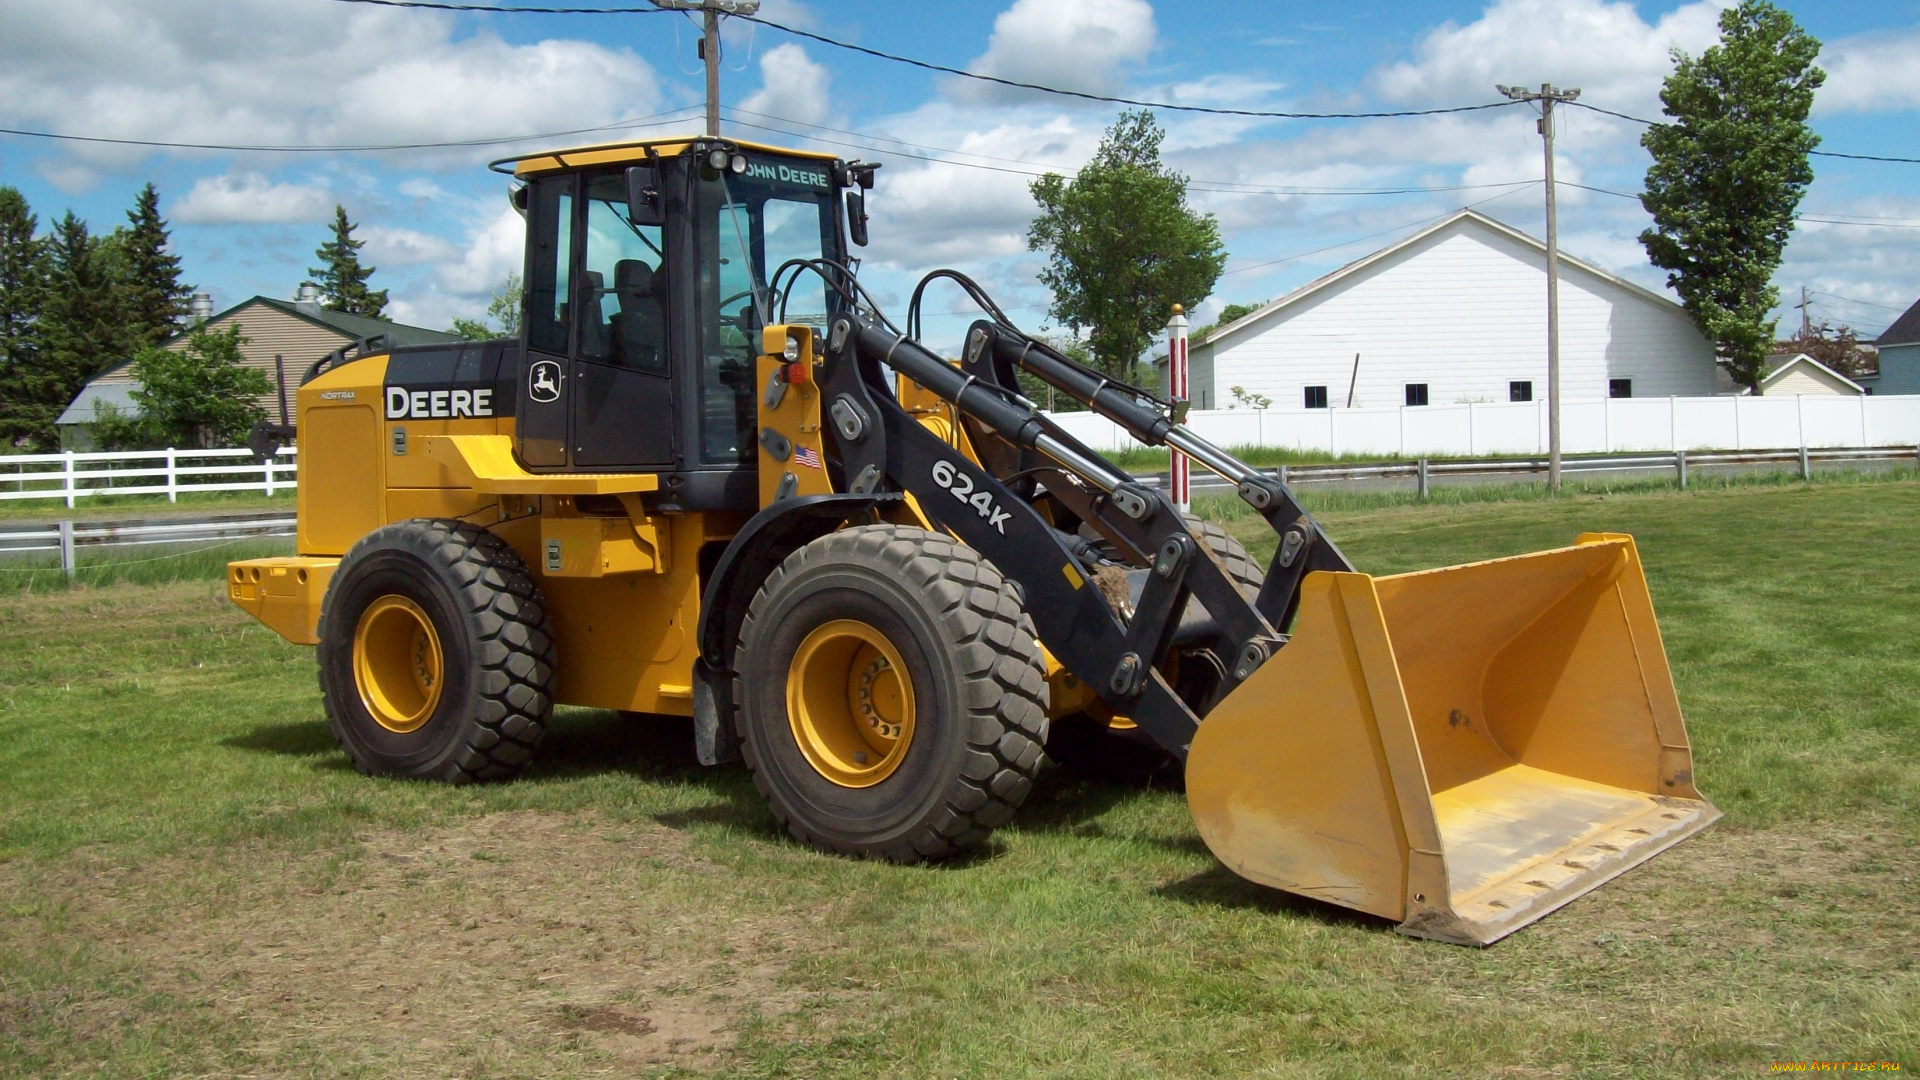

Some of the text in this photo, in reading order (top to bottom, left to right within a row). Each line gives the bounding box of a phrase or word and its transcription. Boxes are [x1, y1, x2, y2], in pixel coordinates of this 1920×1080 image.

[745, 163, 828, 188] OHN DEERE
[321, 391, 356, 400] NORTRAX
[386, 386, 493, 419] DEERE
[932, 460, 1013, 535] 624K
